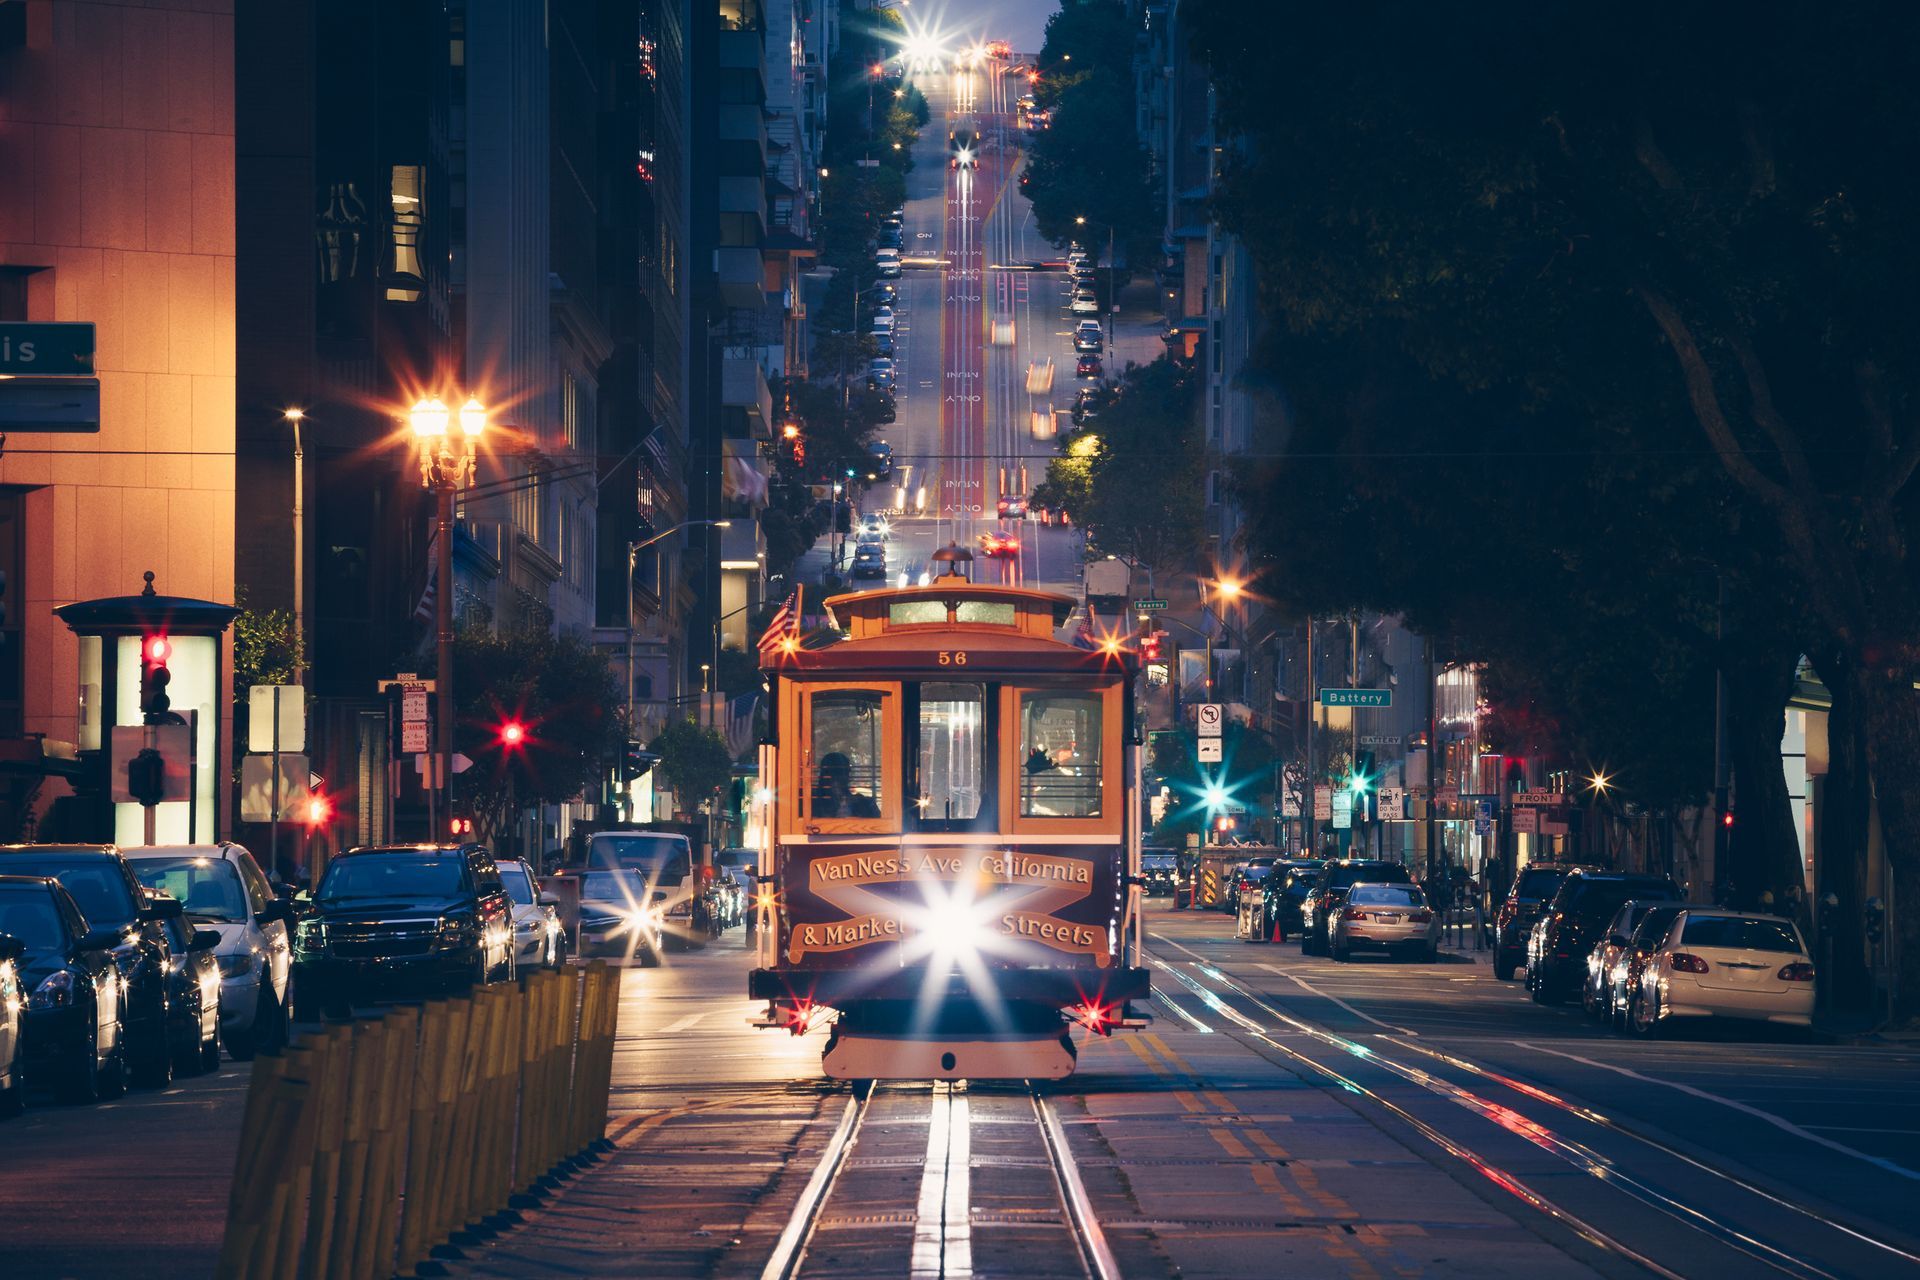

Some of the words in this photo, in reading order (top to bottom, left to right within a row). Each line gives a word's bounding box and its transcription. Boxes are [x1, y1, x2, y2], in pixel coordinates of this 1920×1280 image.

[945, 480, 980, 488] MUNI
[944, 504, 982, 512] ONLY
[938, 651, 967, 665] 56
[1330, 693, 1382, 704] Battery
[1361, 736, 1399, 744] BATTERY
[1519, 794, 1553, 803] FRONT
[803, 925, 819, 945] &
[1001, 914, 1094, 946] Streets
